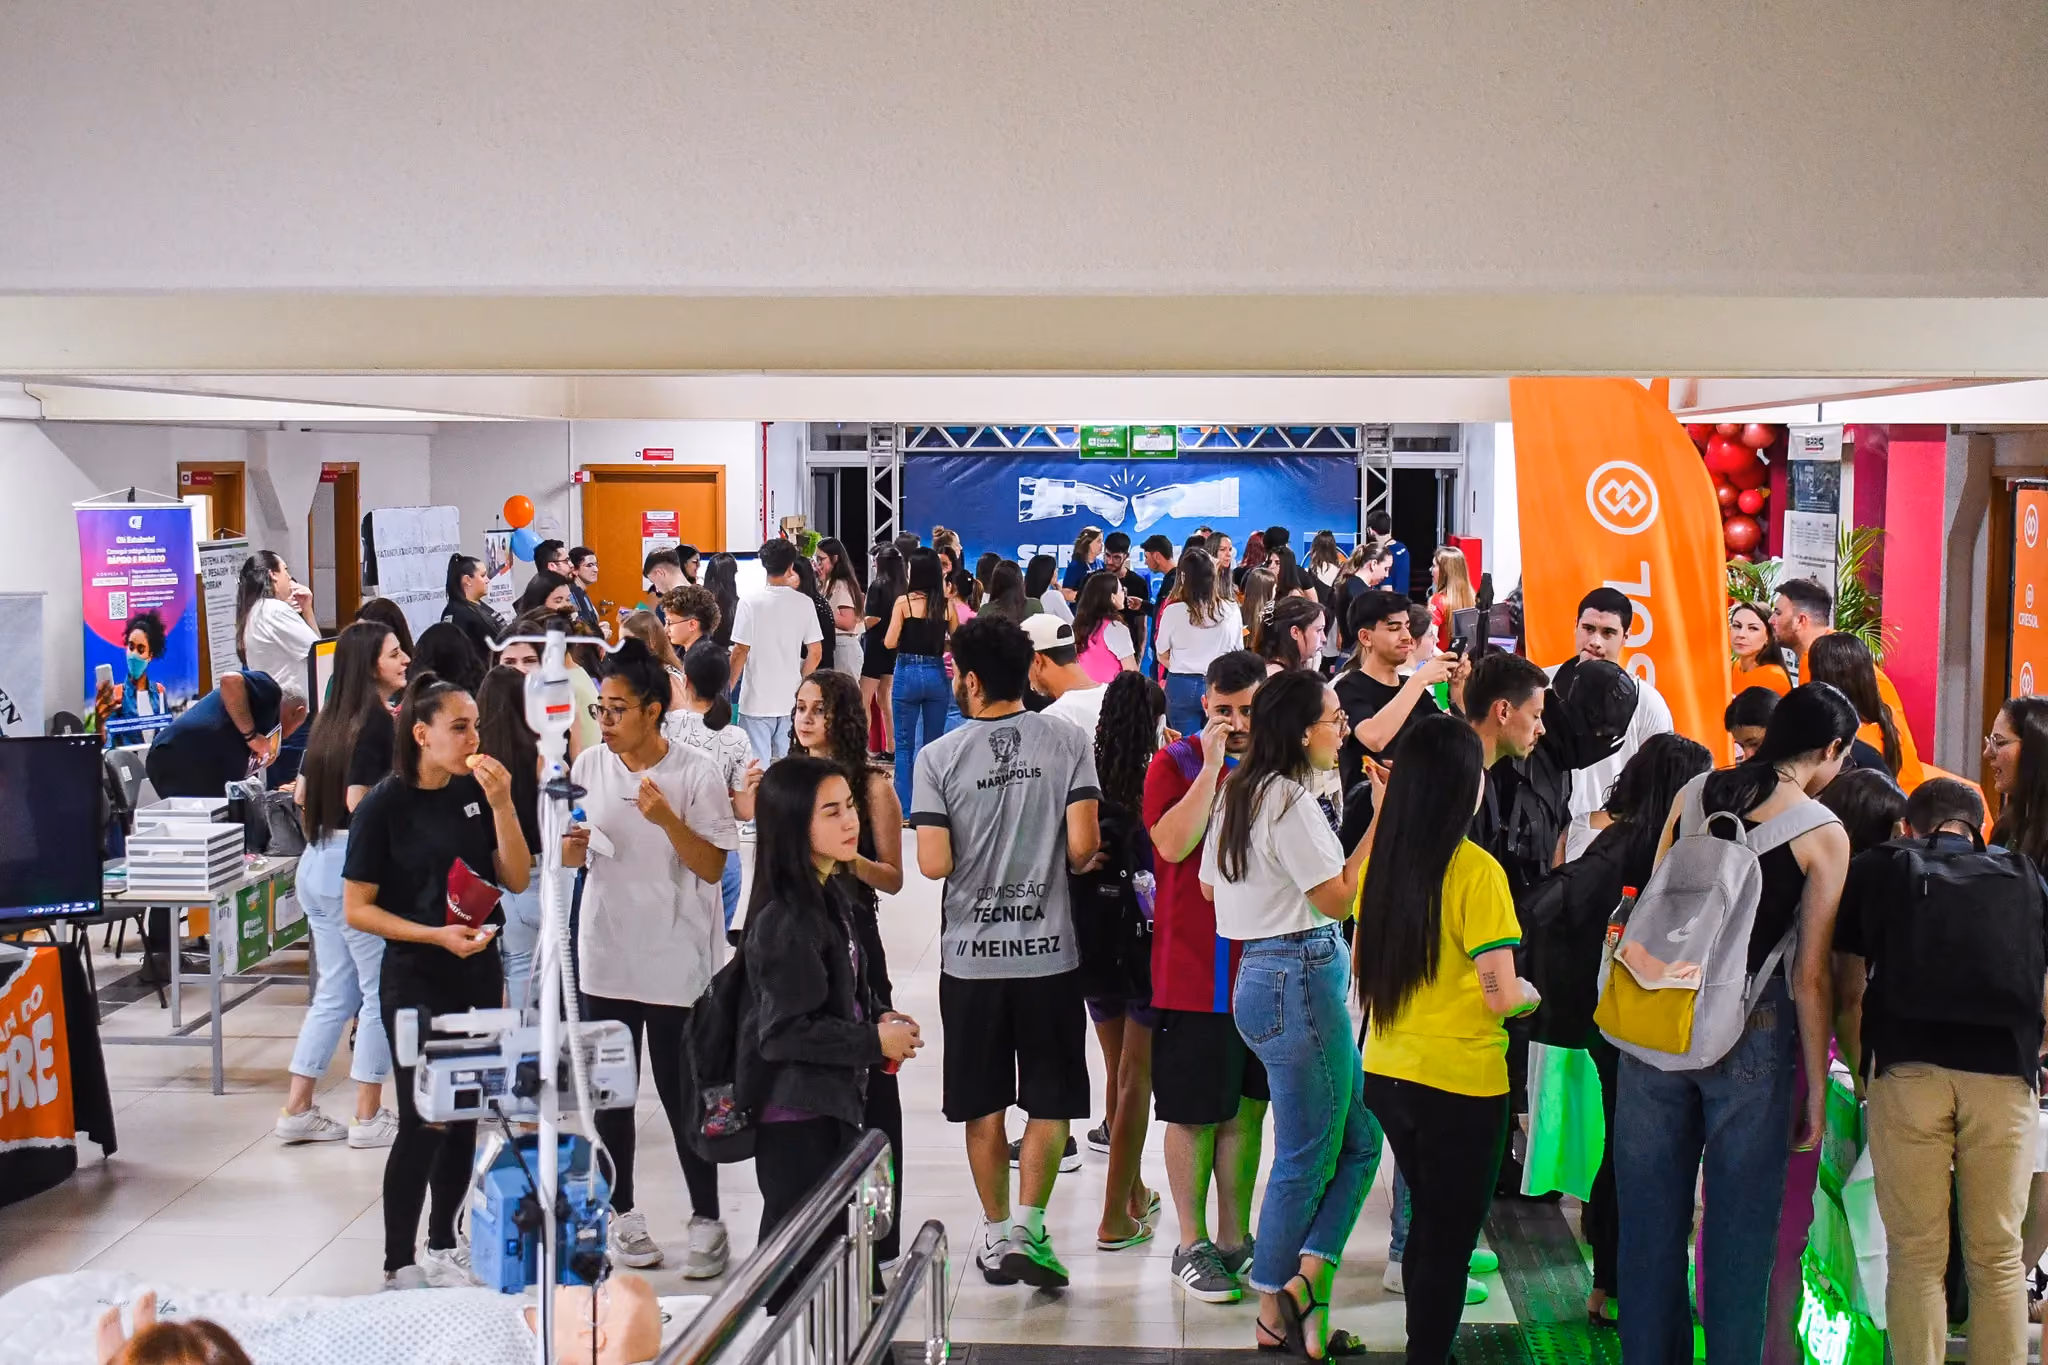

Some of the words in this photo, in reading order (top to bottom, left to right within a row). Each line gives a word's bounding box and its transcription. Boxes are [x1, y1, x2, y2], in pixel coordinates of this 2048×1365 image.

[977, 880, 1047, 900] COMISSÃO
[973, 904, 1045, 923] TÉCNICA
[972, 936, 1061, 957] MEINERZ
